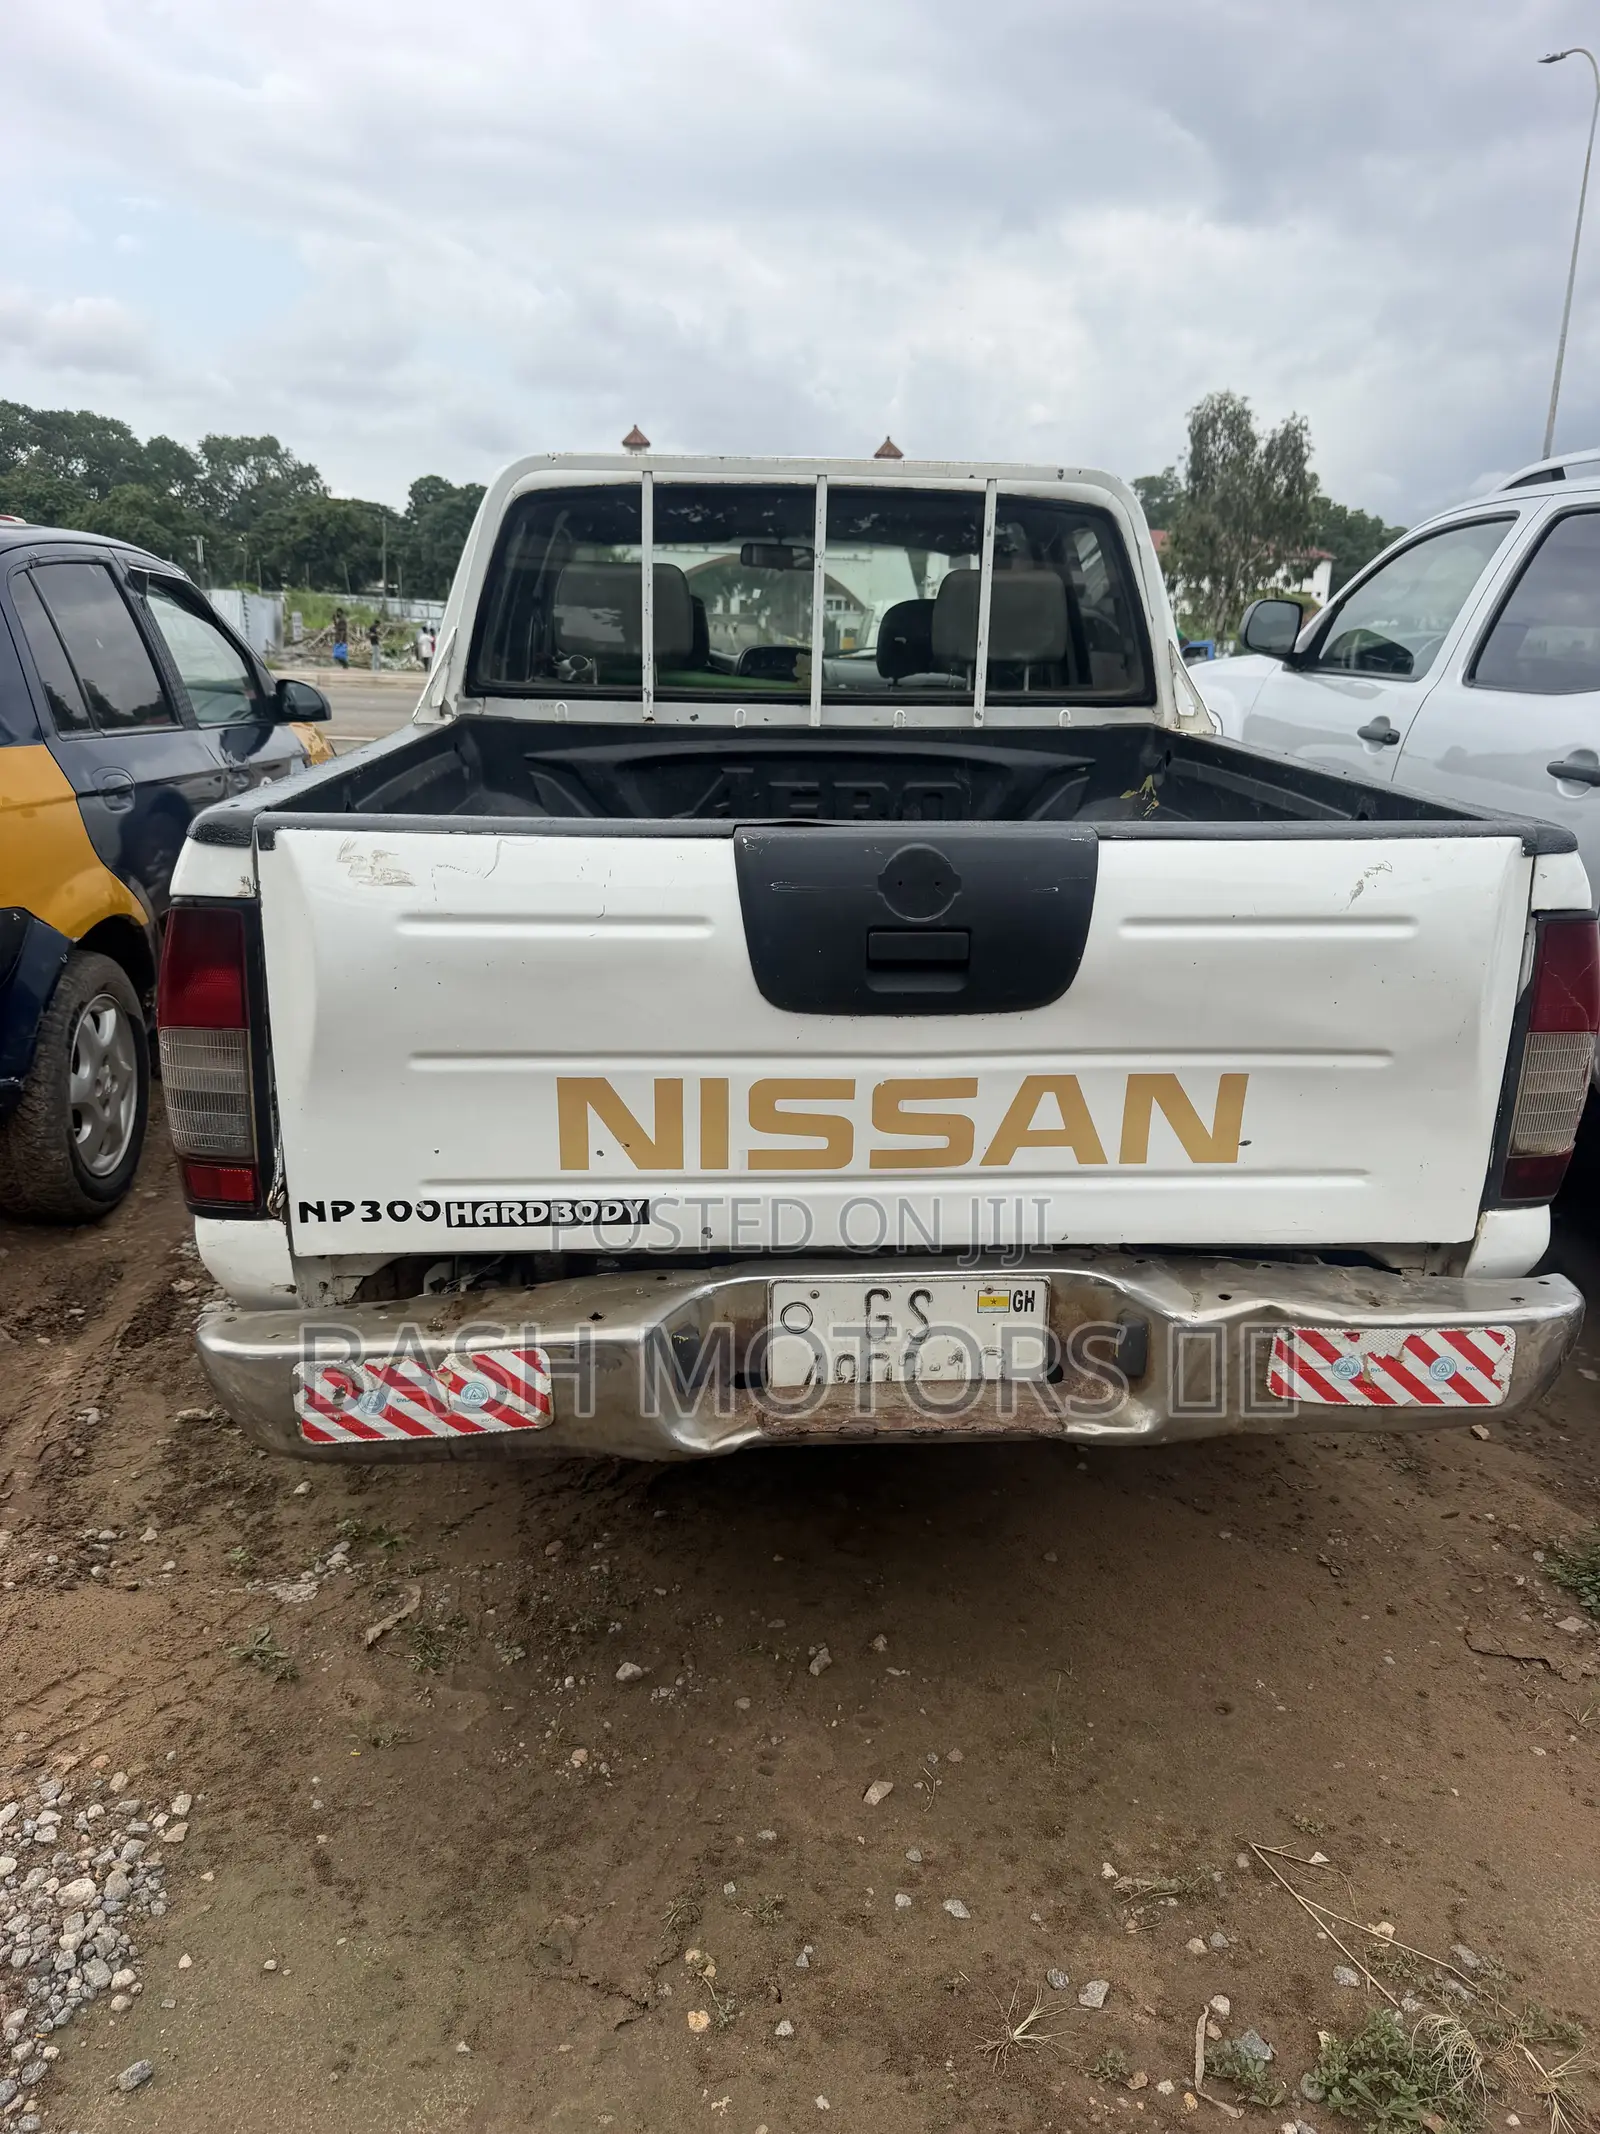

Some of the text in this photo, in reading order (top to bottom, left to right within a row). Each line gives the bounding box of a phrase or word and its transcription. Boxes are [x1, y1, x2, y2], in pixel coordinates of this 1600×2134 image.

[556, 1073, 1249, 1170] NISSAN
[299, 1200, 646, 1227] NP300 HARDBODY
[1012, 1289, 1035, 1312] GH
